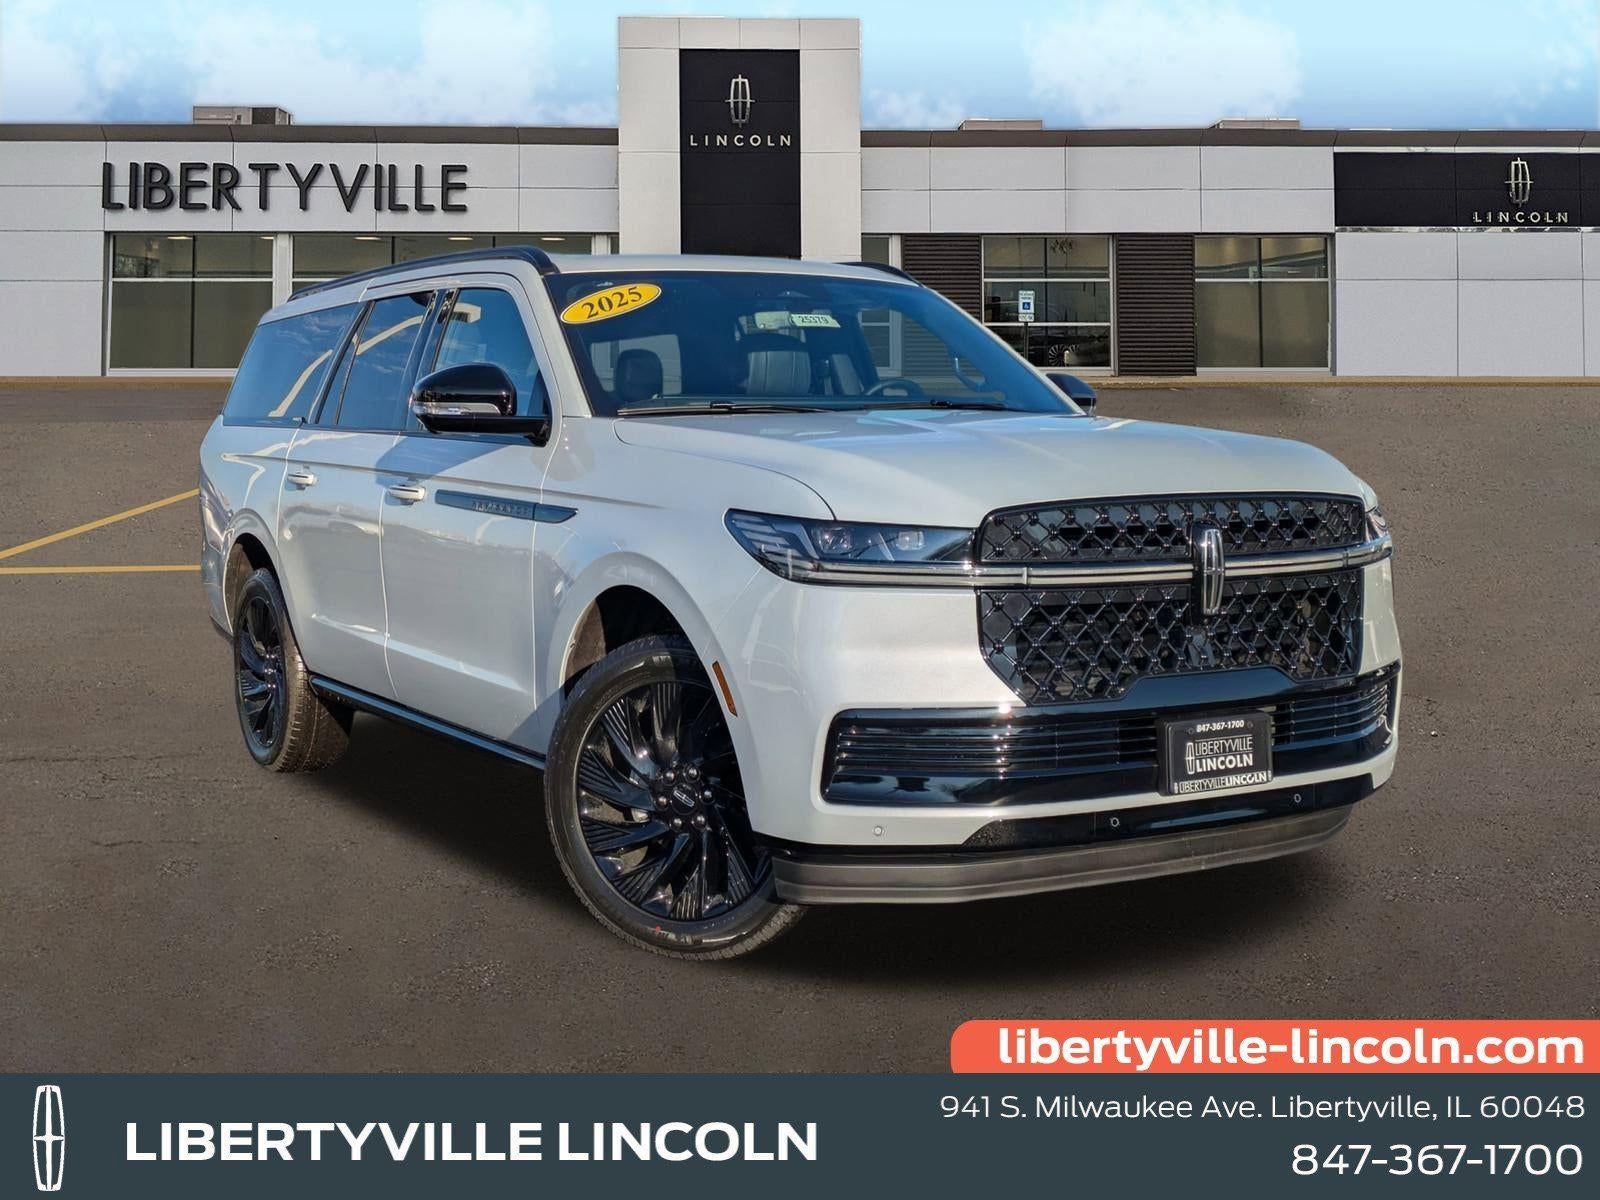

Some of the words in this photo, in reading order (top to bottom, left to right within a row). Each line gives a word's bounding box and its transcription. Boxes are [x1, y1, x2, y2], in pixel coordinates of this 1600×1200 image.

[690, 134, 791, 147] LINCOLN
[101, 161, 468, 212] LIBERTYVILLE
[1473, 211, 1568, 223] LINCOLN
[581, 286, 643, 319] 2025
[1196, 719, 1245, 733] 847-367-1700
[1195, 736, 1253, 757] LIBERTYVILLE
[1195, 753, 1254, 773] LINCOLN
